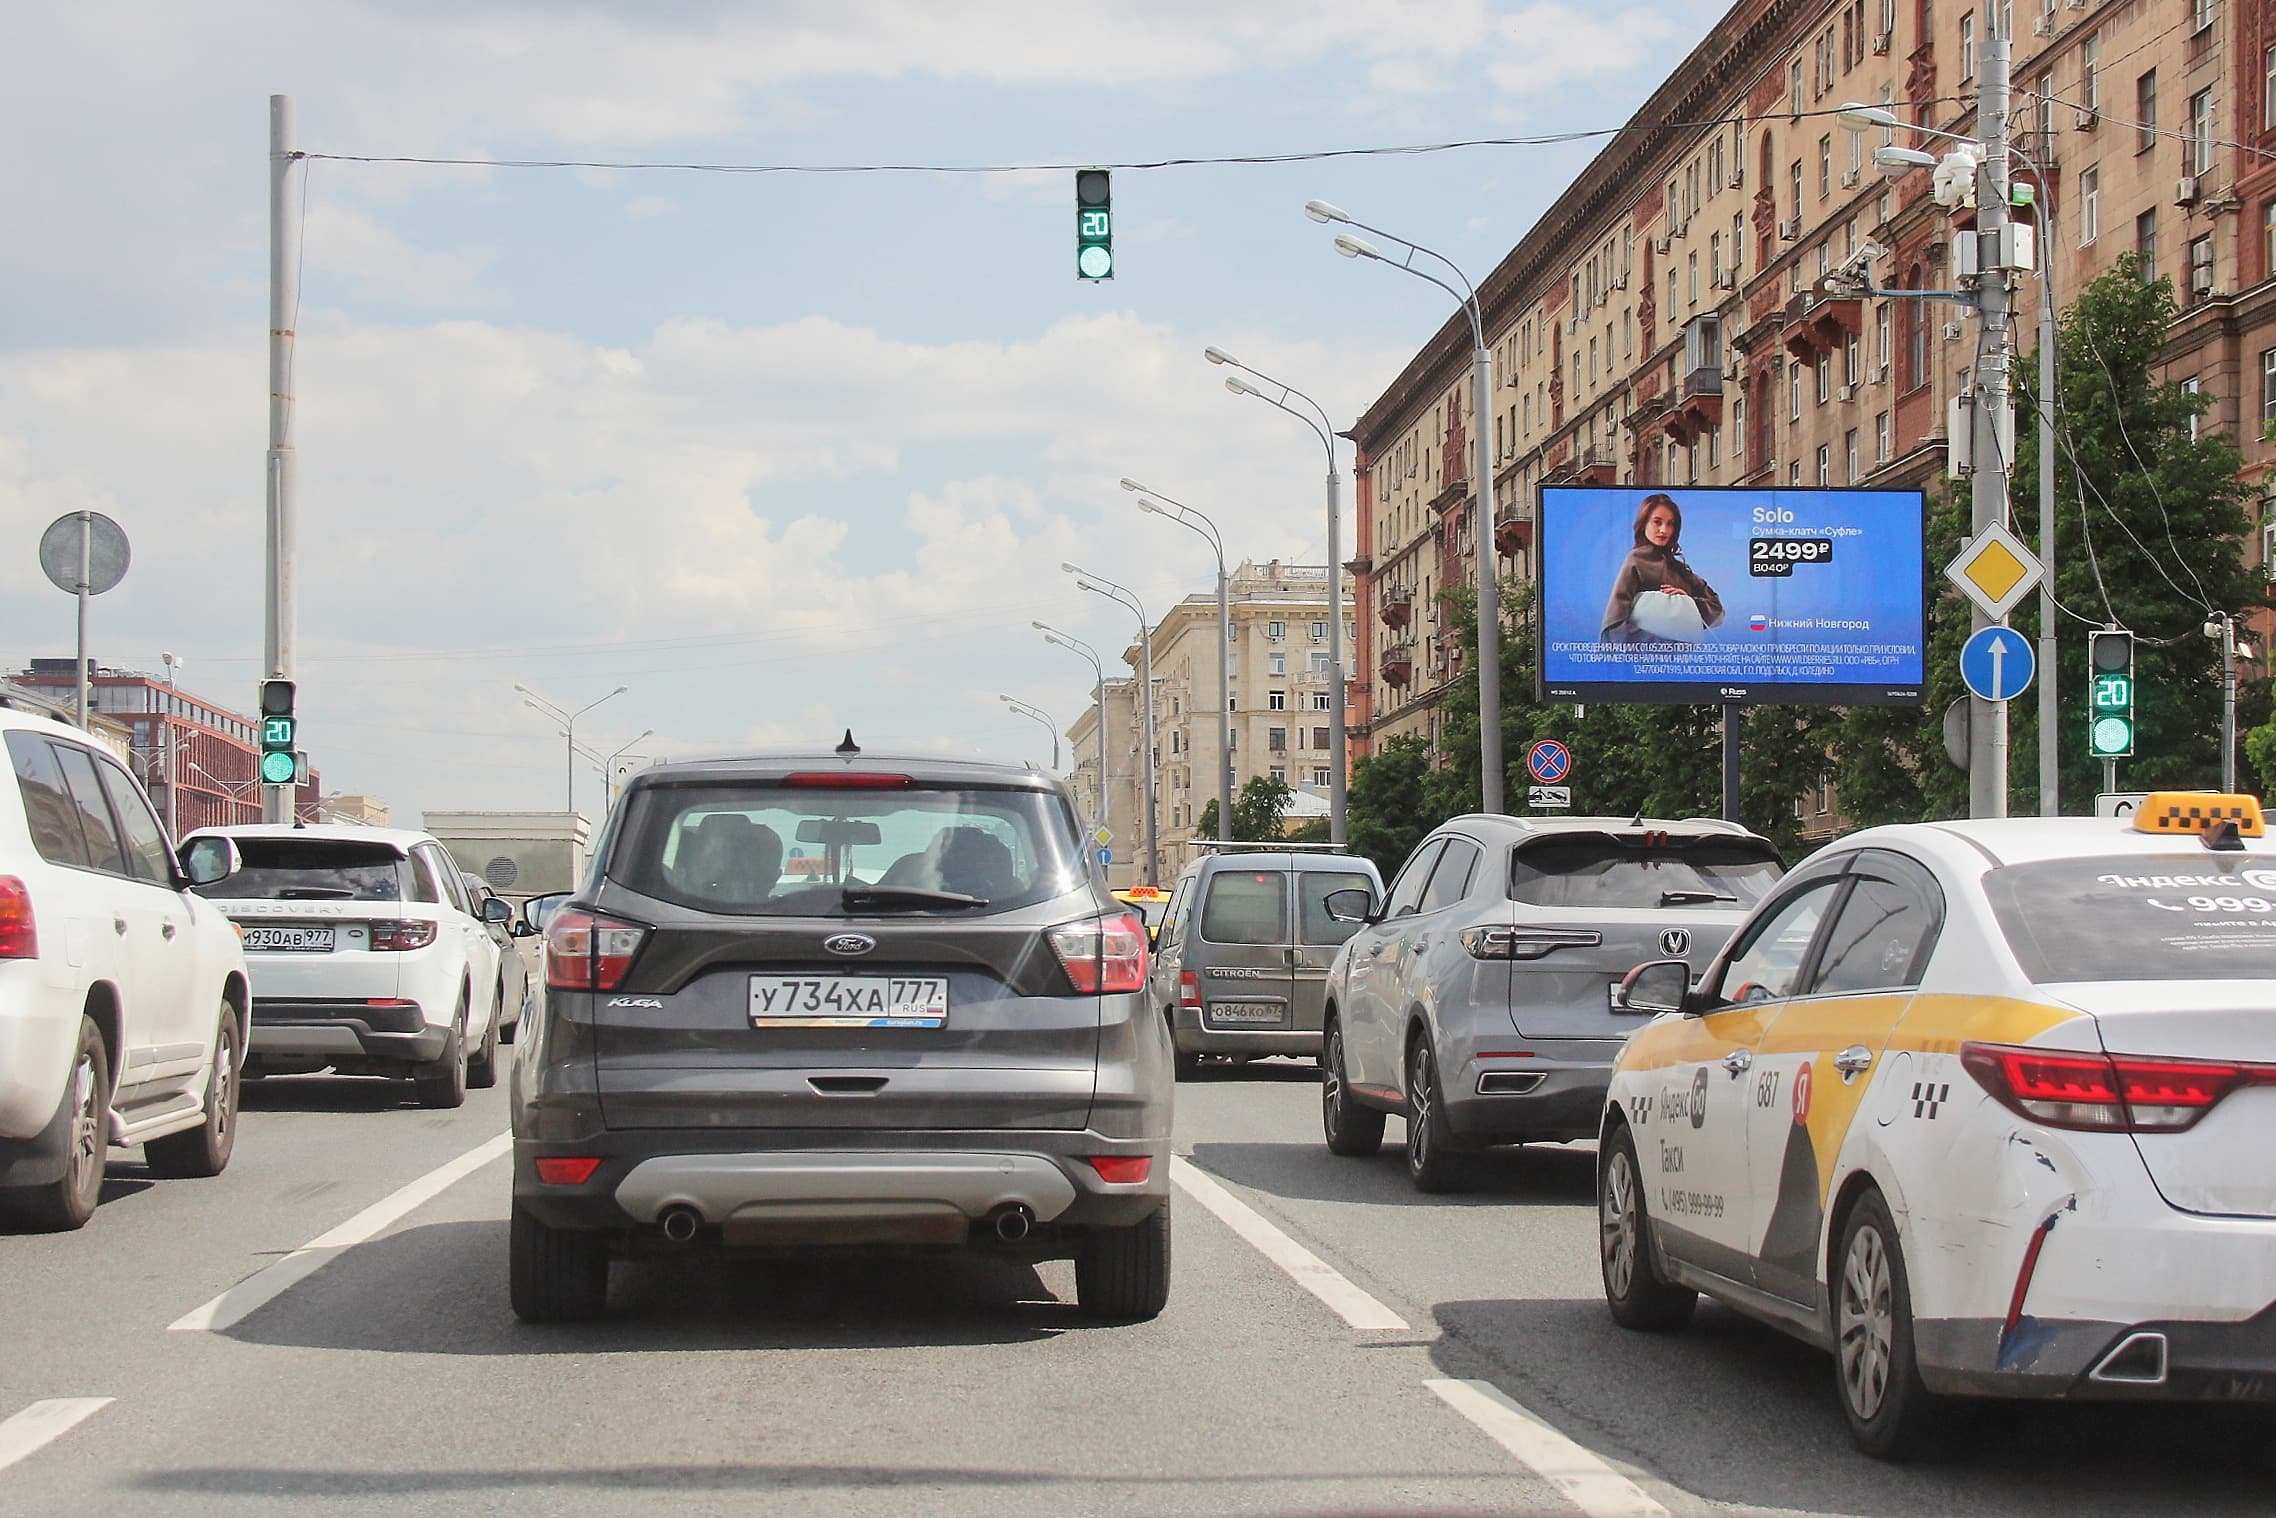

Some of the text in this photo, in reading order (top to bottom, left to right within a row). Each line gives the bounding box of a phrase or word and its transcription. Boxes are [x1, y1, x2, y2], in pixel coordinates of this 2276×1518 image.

[1082, 212, 1109, 236] 20
[1752, 507, 1794, 523] Solo
[1752, 526, 1817, 537] Сумка-клатч
[1768, 618, 1870, 631] Нижний Новгород
[2097, 681, 2127, 706] 20
[266, 721, 291, 742] 20
[2097, 874, 2241, 888] Яндекс
[305, 930, 330, 942] 977
[836, 937, 864, 950] Ford
[761, 980, 938, 1012] У734ХА 777
[902, 1004, 926, 1013] RUS
[1757, 1071, 1780, 1108] 687
[1796, 1073, 1809, 1115] Я
[1660, 1085, 1690, 1124] Яндекс
[1660, 1138, 1684, 1173] Такси
[1669, 1187, 1725, 1218] (495) 999-99-99
